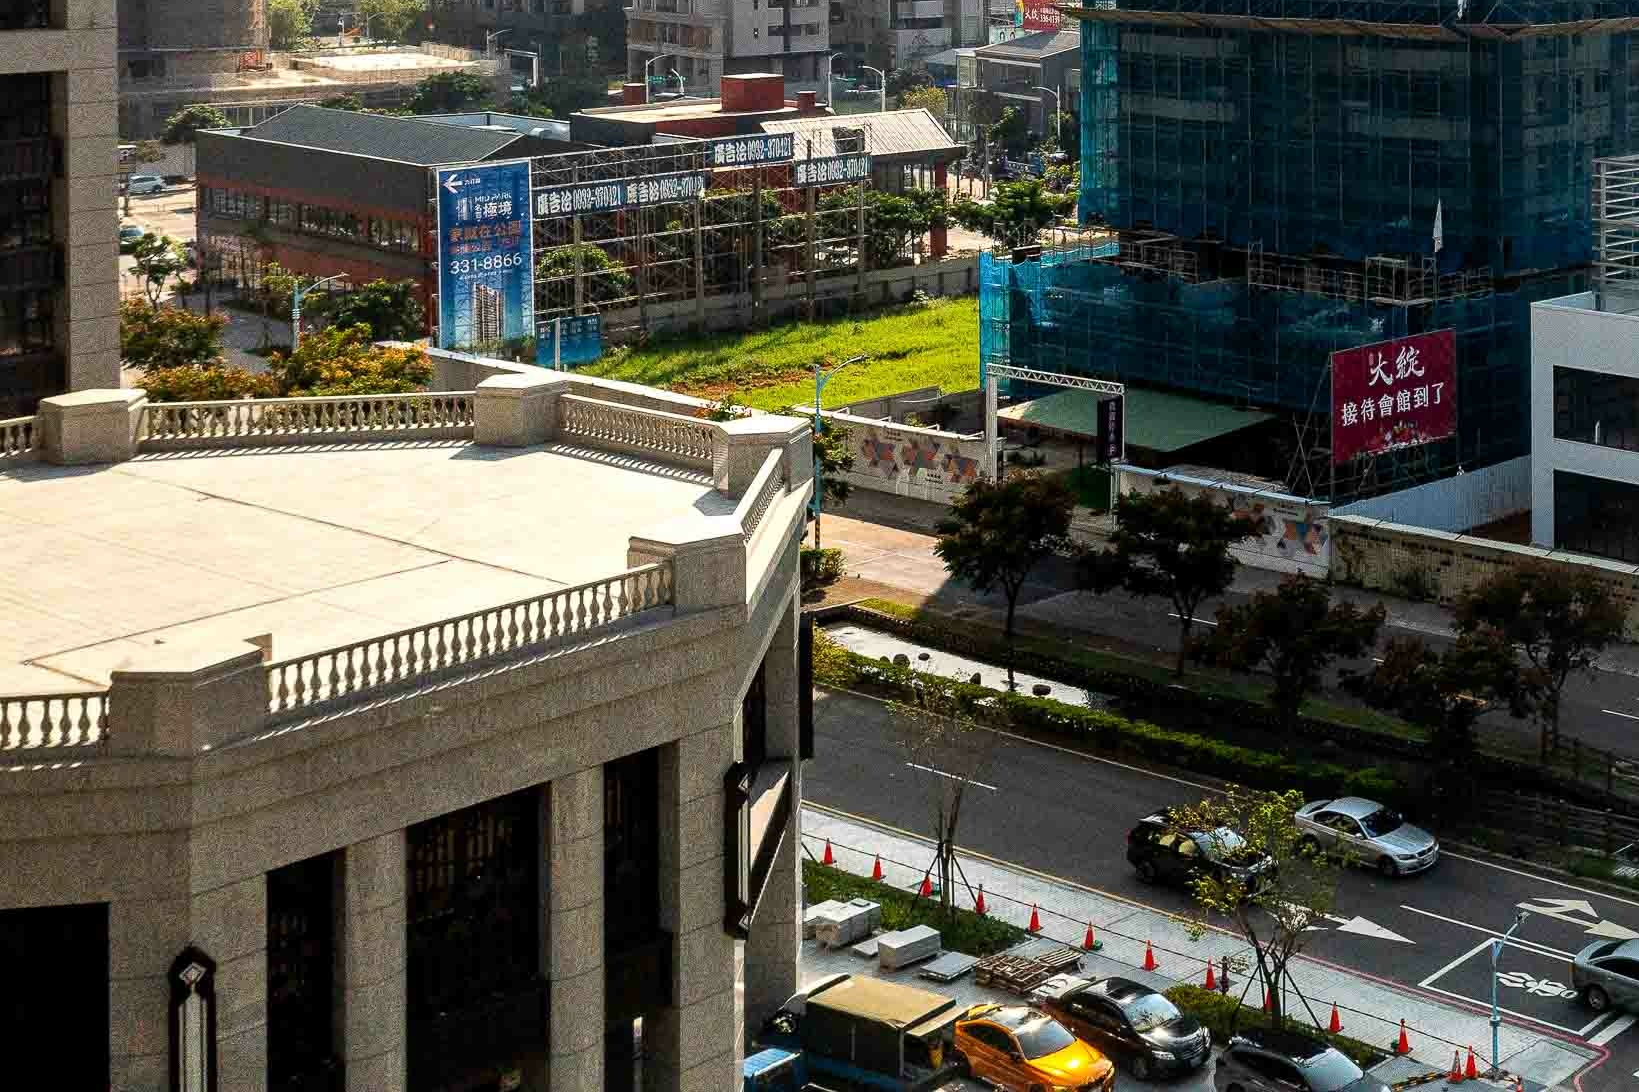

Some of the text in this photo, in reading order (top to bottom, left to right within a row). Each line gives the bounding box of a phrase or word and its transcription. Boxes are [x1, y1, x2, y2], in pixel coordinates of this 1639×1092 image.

[450, 252, 523, 275] 331-8866
[1341, 382, 1445, 427] 接待會館到了
